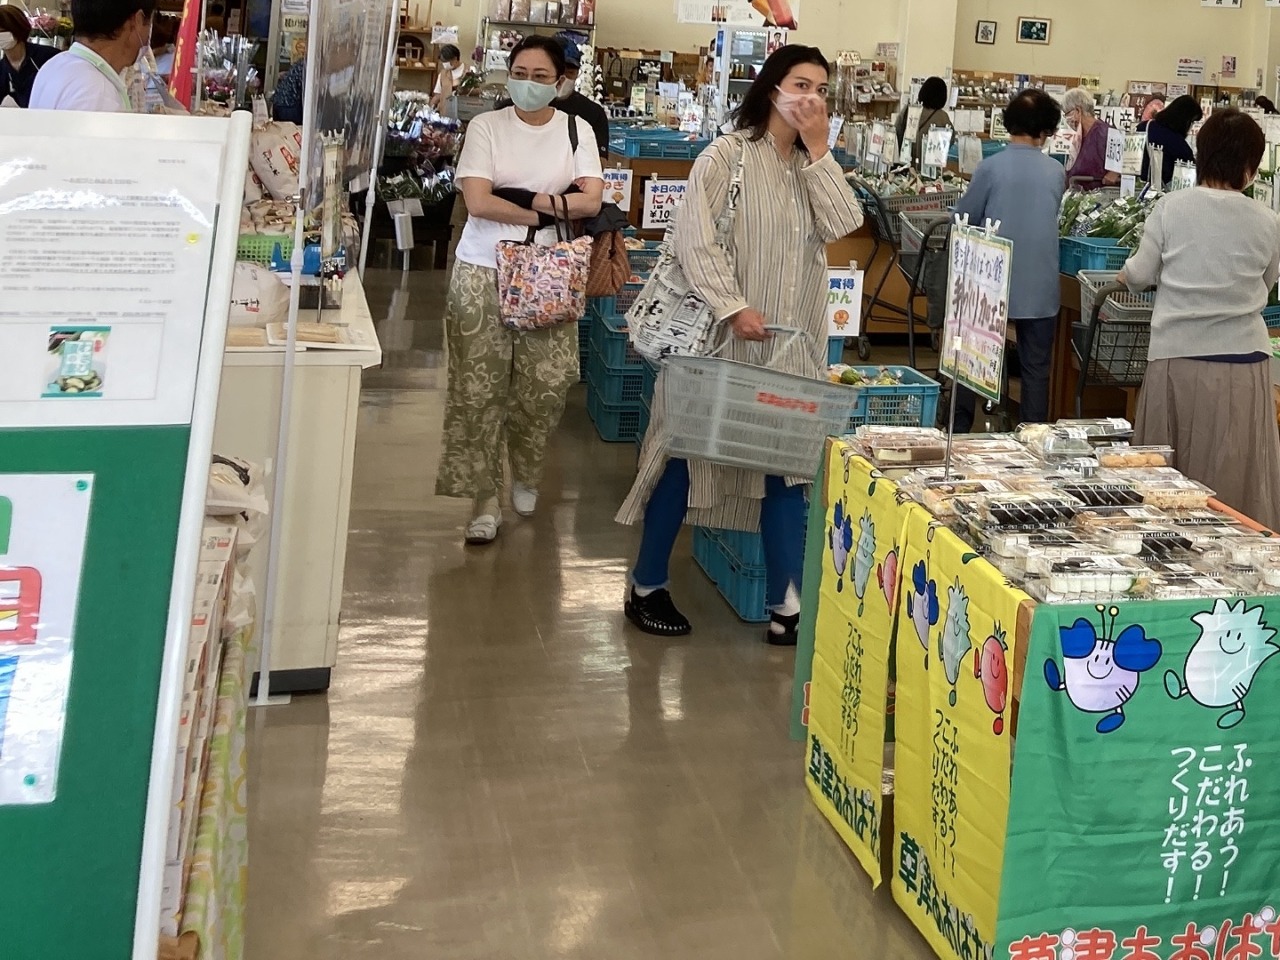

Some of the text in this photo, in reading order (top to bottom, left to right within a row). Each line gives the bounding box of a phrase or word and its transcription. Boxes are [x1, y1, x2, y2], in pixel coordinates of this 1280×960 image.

[1160, 745, 1196, 904] つくりだす！
[1189, 744, 1226, 901] こだわる！
[1219, 743, 1253, 897] ふれあう！
